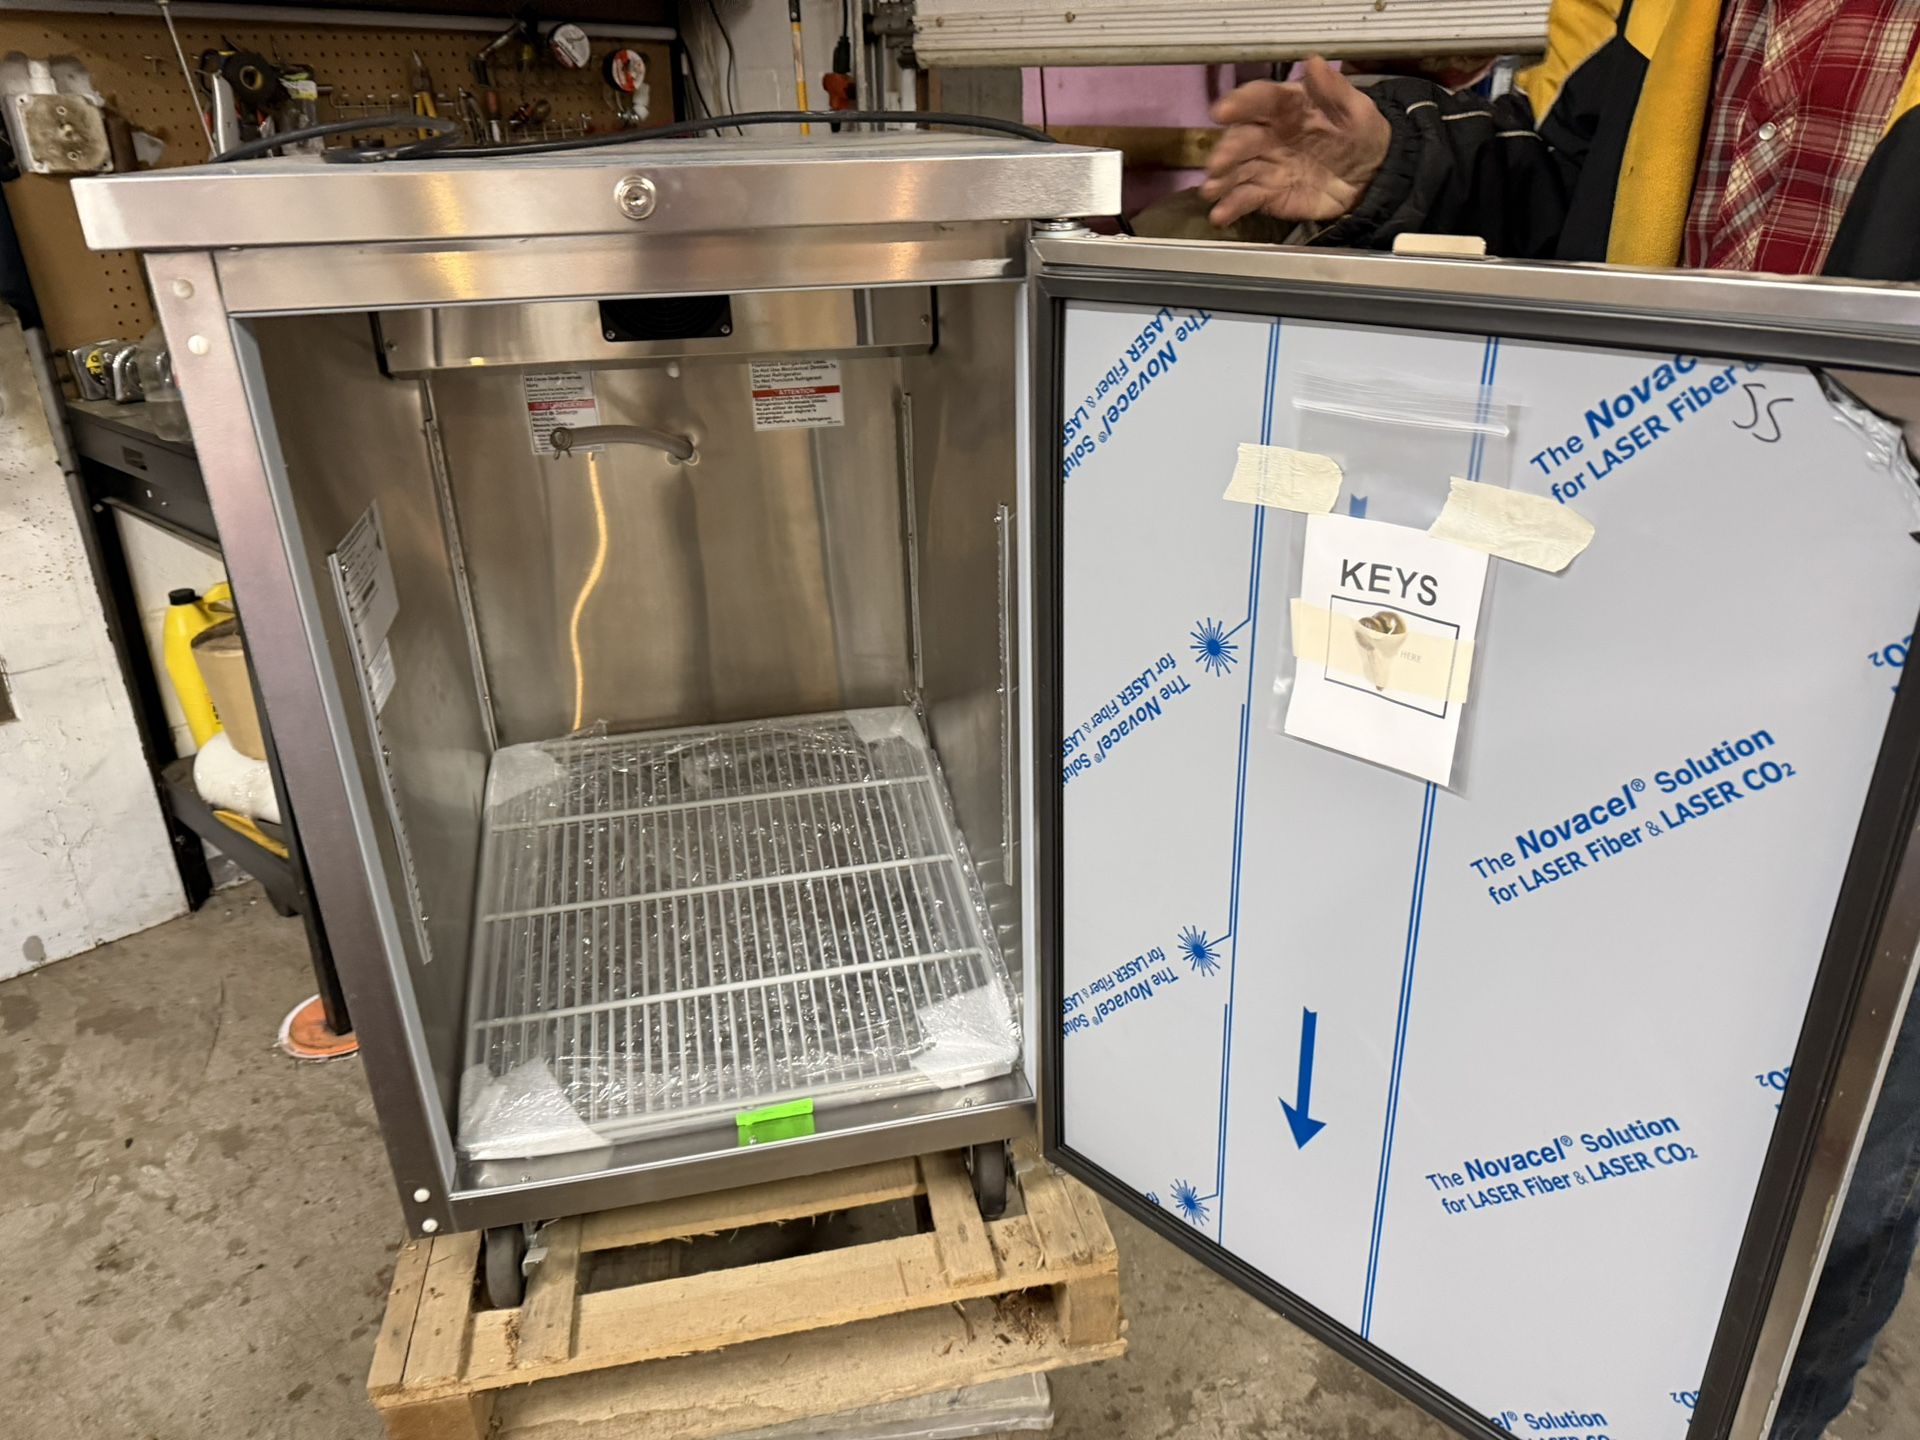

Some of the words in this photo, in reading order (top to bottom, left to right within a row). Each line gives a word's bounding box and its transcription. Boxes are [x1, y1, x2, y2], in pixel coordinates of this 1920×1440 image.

[1124, 307, 1175, 363] LASER
[1175, 308, 1213, 343] The
[1096, 358, 1131, 401] Fiber
[1084, 395, 1097, 408] &
[1550, 472, 1586, 504] for
[1586, 414, 1671, 479] LASER
[1667, 364, 1739, 423] Fiber
[1530, 434, 1584, 475] The
[1340, 558, 1439, 607] KEYS
[1155, 653, 1177, 674] for
[1117, 668, 1158, 706] LASER
[1161, 675, 1191, 700] The
[1081, 723, 1092, 734] &
[1090, 699, 1121, 727] Fiber
[1470, 851, 1517, 879] The
[1515, 778, 1646, 859] Novacel®
[1654, 729, 1775, 794] Solution
[1488, 882, 1519, 905] for
[1518, 851, 1588, 893] LASER
[1585, 826, 1643, 862] Fiber
[1644, 820, 1664, 838] &
[1660, 780, 1744, 830] LASER
[1113, 954, 1150, 984] LASER
[1147, 946, 1166, 963] for
[1089, 974, 1115, 995] Fiber
[1153, 967, 1179, 987] The
[1426, 1172, 1465, 1192] The
[1463, 1135, 1573, 1182] Novacel®
[1580, 1115, 1680, 1153] Solution
[1442, 1197, 1467, 1215] for
[1466, 1183, 1526, 1210] LASER
[1523, 1173, 1571, 1198] Fiber
[1572, 1170, 1589, 1185] &
[1585, 1151, 1655, 1183] LASER
[1524, 1410, 1608, 1430] Solution
